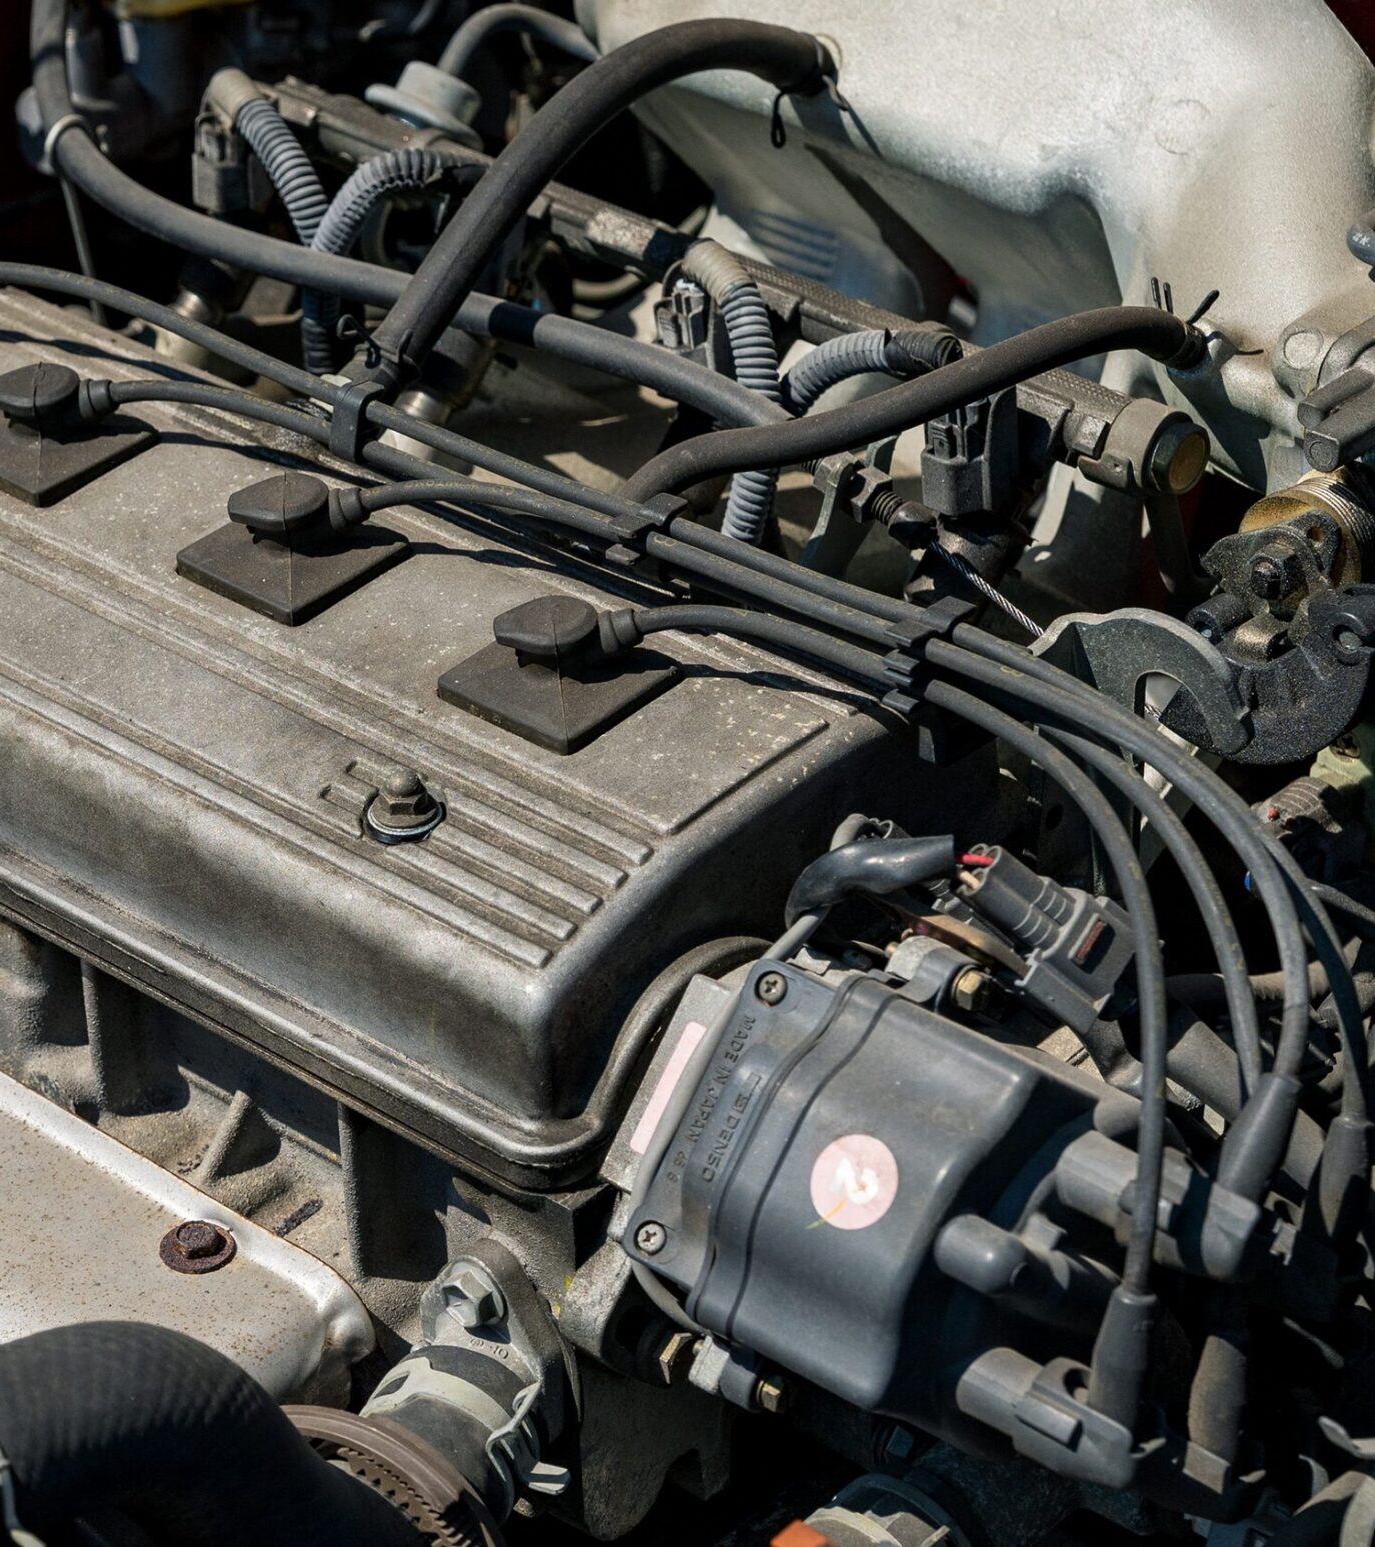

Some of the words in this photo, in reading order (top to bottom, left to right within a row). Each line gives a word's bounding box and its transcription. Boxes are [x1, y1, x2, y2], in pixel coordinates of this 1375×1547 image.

[724, 1015, 756, 1064] MADE
[713, 1067, 732, 1088] IN
[685, 1087, 719, 1144] JAPAN
[702, 1109, 745, 1183] DENSO
